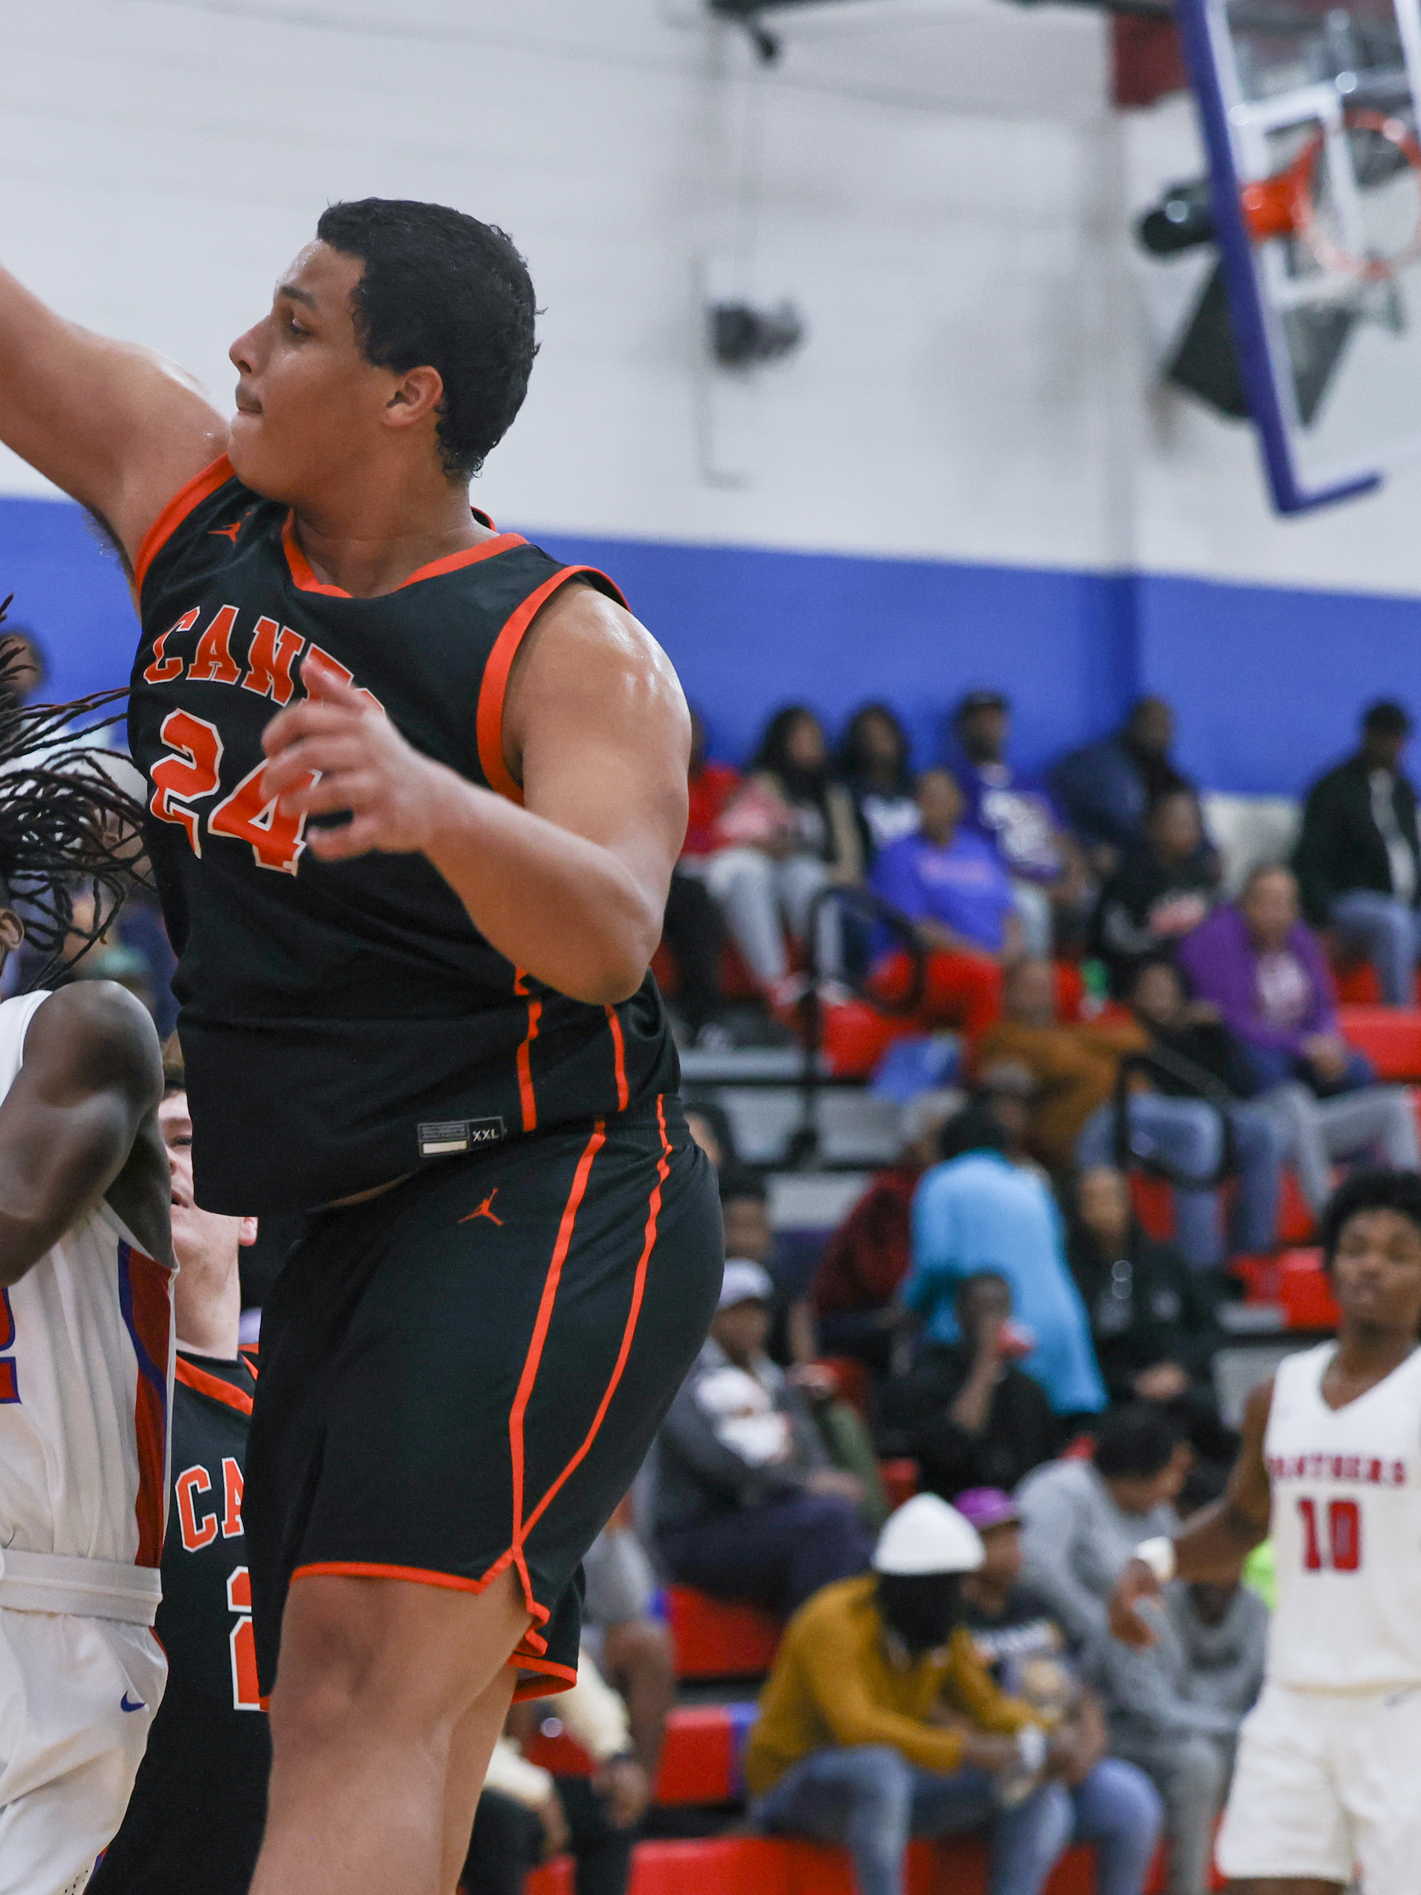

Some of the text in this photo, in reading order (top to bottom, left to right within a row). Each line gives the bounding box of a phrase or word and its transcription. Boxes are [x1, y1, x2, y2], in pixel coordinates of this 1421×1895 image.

[143, 604, 385, 707] CANT
[150, 708, 322, 876] 24
[472, 1128, 500, 1142] XXL
[1296, 1496, 1361, 1572] 10
